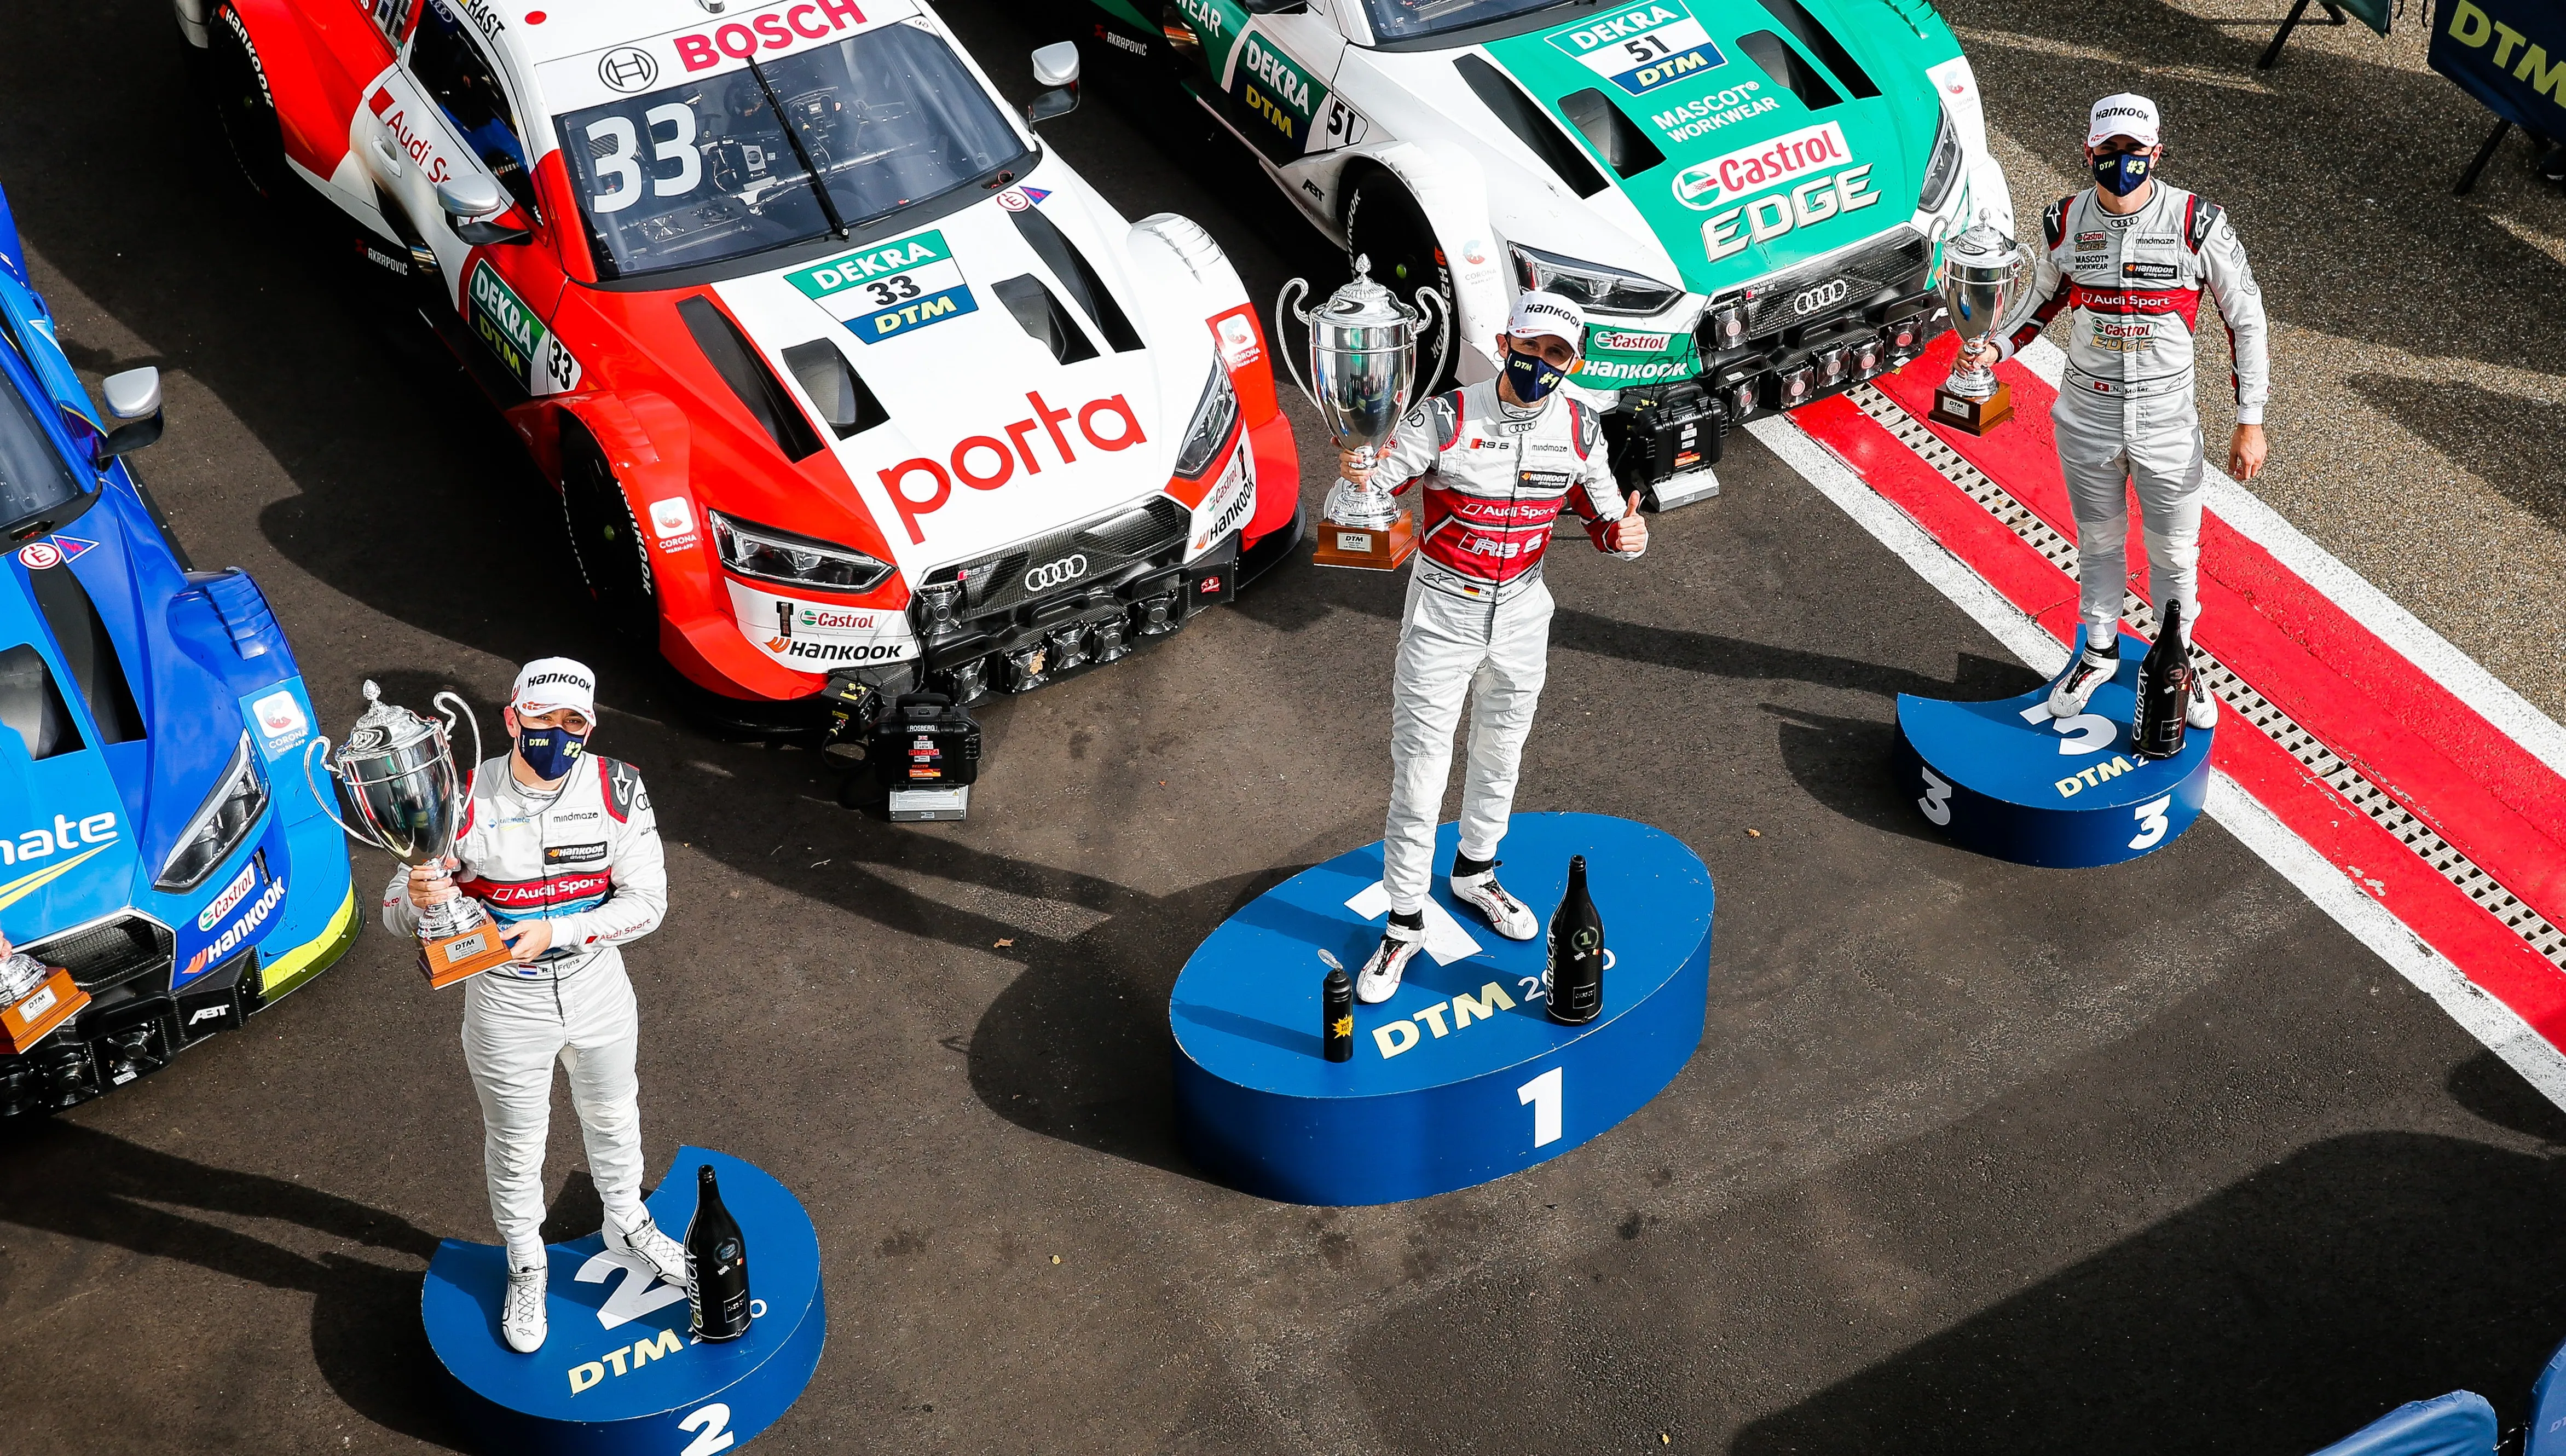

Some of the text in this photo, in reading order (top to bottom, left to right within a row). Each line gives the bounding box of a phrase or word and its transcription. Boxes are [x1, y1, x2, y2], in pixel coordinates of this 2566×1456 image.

[673, 0, 868, 72] BOSCH
[1569, 5, 1679, 50] DEKRA
[1623, 35, 1672, 63] 51
[2448, 0, 2566, 109] DTM
[1246, 39, 1309, 116] DEKRA
[1634, 51, 1709, 88] DTM
[1245, 84, 1293, 139] DTM
[1328, 105, 1357, 146] 51
[1666, 96, 1781, 143] WORKWEAR
[386, 110, 432, 166] Audi
[583, 102, 702, 213] 33
[1720, 129, 1842, 193] Castrol
[2126, 160, 2146, 175] #3
[1301, 178, 1325, 203] ABT
[1699, 163, 1883, 264] EDGE
[2135, 237, 2176, 245] mindmaze
[811, 240, 937, 291] DEKRA
[1465, 268, 1496, 281] CORONA
[866, 275, 922, 306] 33
[2094, 294, 2171, 308] Audi Sport
[475, 267, 533, 354] DEKRA
[873, 294, 958, 336] DTM
[478, 313, 523, 379] DTM
[1613, 334, 1666, 349] Castrol
[2089, 334, 2157, 354] EDGE
[2105, 323, 2151, 338] Castrol
[548, 340, 574, 390] 33
[1514, 360, 1533, 372] DTM
[1949, 400, 1964, 409] DTM
[1531, 444, 1568, 453] mindmaze
[876, 390, 1148, 545] porta
[1216, 464, 1238, 504] Castrol
[1483, 505, 1556, 519] Audi Sport
[658, 534, 697, 550] CORONA
[665, 543, 694, 554] WARN-APP
[818, 612, 874, 628] Castrol
[268, 729, 308, 750] CORONA
[275, 739, 307, 755] WARN-APP
[529, 738, 549, 747] DTM
[563, 740, 583, 758] #2
[2054, 755, 2134, 799] DTM
[1917, 767, 1952, 825] 3
[553, 811, 599, 823] mindmaze
[2127, 794, 2171, 850] 3
[213, 870, 253, 919] Castrol
[515, 877, 607, 900] Audi Sport
[455, 938, 475, 951] DTM
[599, 918, 652, 941] Audi Sport
[1580, 932, 1592, 945] 1
[557, 957, 580, 973] Frijns
[28, 993, 45, 1009] DTM
[188, 1004, 230, 1026] ABT
[1370, 981, 1517, 1061] DTM
[1515, 1066, 1563, 1150] 1
[573, 1249, 689, 1331] 2
[567, 1327, 684, 1398] DTM
[677, 1402, 736, 1456] 2
